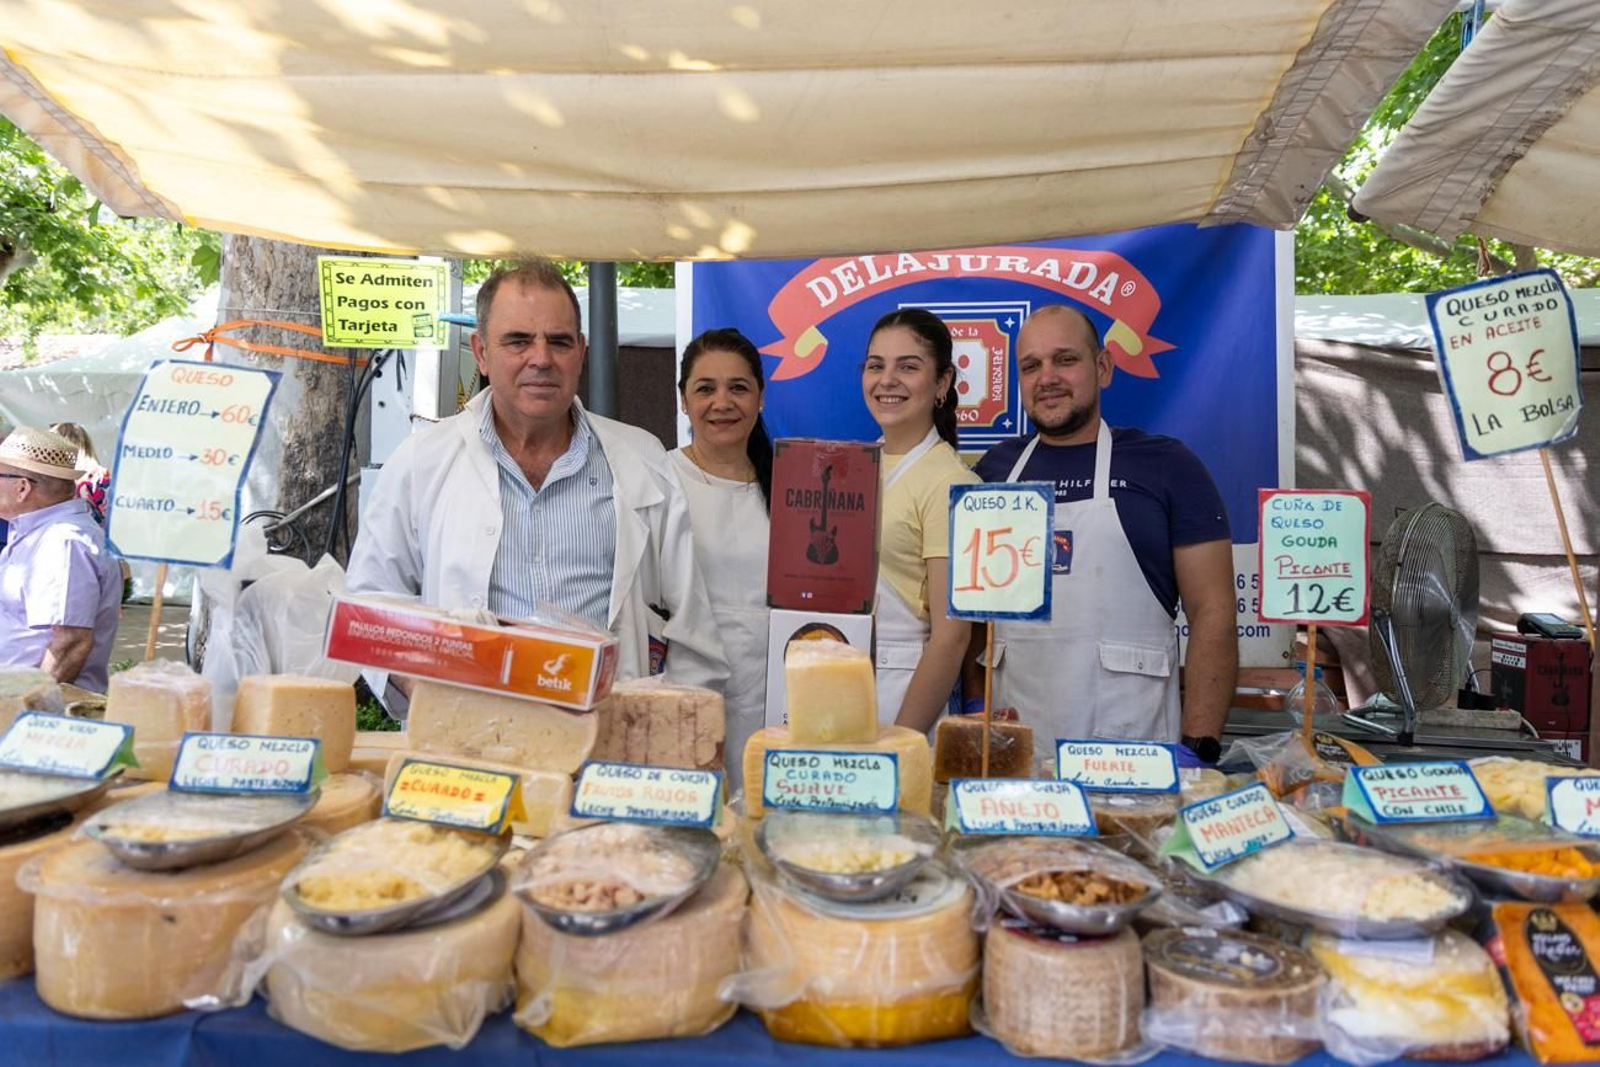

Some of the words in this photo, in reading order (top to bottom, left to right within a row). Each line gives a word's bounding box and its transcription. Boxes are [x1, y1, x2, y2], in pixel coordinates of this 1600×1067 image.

[336, 272, 355, 284] Se
[360, 273, 433, 288] Admiten
[337, 296, 389, 311] Pagos
[395, 299, 426, 310] con
[1446, 289, 1510, 318] QUESO
[1459, 298, 1560, 327] CURADO
[338, 318, 398, 335] Tarjeta
[1450, 333, 1473, 350] EN
[1486, 316, 1542, 341] ACEITE
[171, 366, 234, 387] QUESO
[137, 395, 200, 416] ENTERO
[1472, 412, 1503, 436] LA
[122, 444, 173, 460] MEDIO
[115, 496, 175, 512] CUARTO
[964, 495, 1006, 512] QUESO
[1272, 498, 1315, 512] CUÑA
[1322, 499, 1342, 512] DE
[1271, 517, 1324, 529] QUESO
[1281, 535, 1338, 549] GOUDA
[954, 527, 1042, 592] 15€
[1274, 555, 1351, 576] PICANTE
[1282, 582, 1355, 615] 12€
[537, 673, 572, 690] betik
[197, 737, 251, 750] QUESO
[1068, 745, 1103, 756] QUESO
[1115, 747, 1159, 757] MEZCLA
[769, 754, 820, 769] QUESO
[832, 757, 881, 770] MEZCLA
[1084, 759, 1137, 773] FUERTE
[597, 766, 642, 780] QUESO
[786, 769, 857, 783] CURADO
[1362, 768, 1418, 781] QUESO
[1373, 785, 1462, 801] PICANTE
[1383, 805, 1414, 817] CON
[1424, 804, 1466, 816] CHILE
[1200, 805, 1277, 844] MANTECA
